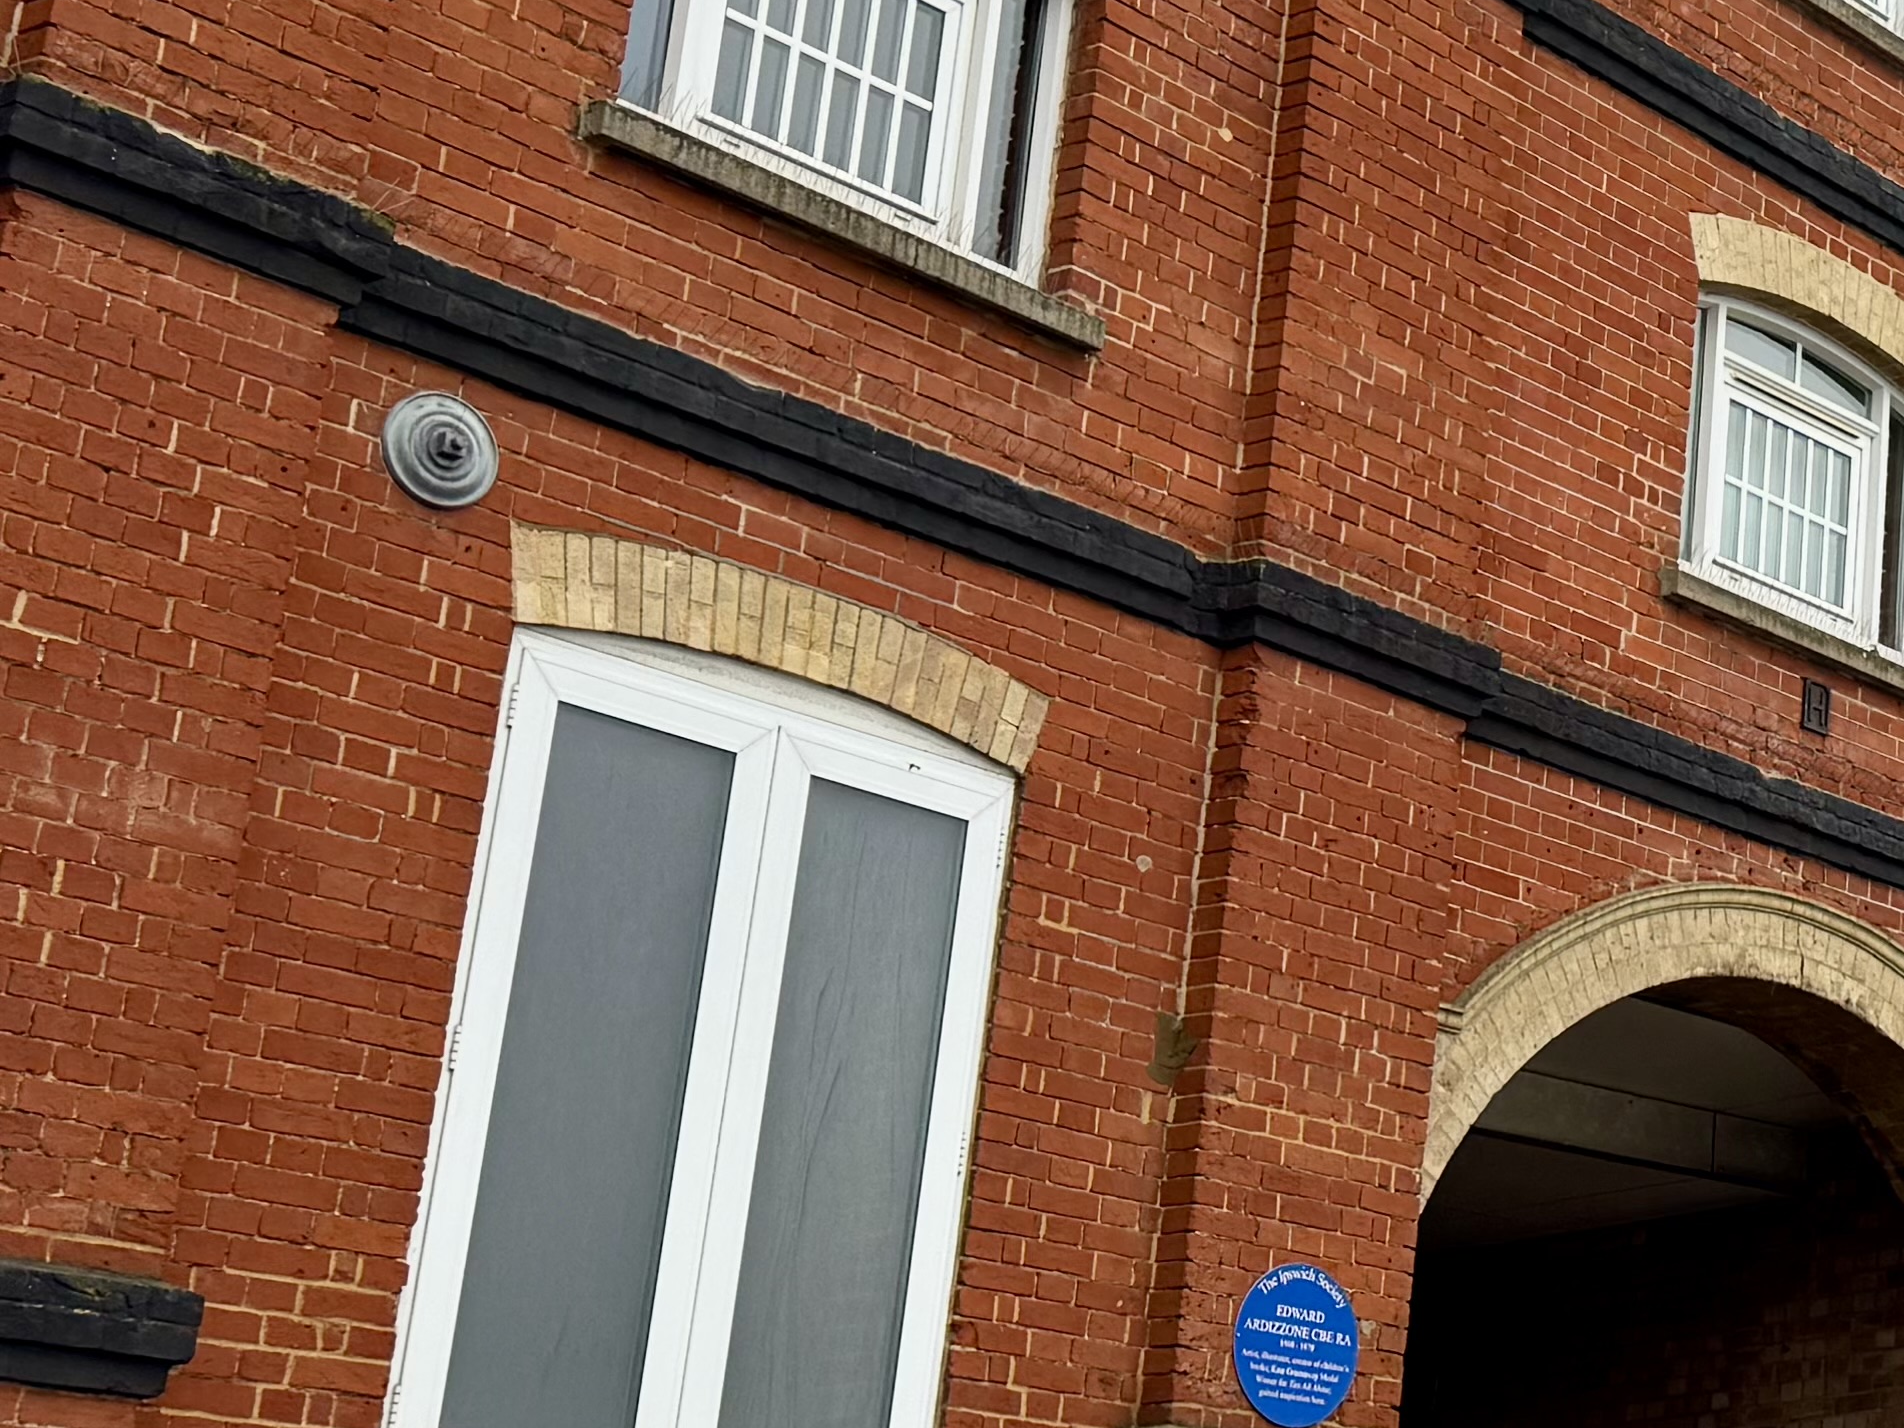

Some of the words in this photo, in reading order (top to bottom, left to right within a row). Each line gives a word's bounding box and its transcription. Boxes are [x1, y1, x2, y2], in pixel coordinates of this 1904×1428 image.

[1257, 1276, 1278, 1294] The
[1279, 1266, 1316, 1285] Ipswich
[1316, 1273, 1347, 1308] Society
[1276, 1304, 1325, 1323] EDWARD
[1244, 1318, 1310, 1339] ARDIZZONE
[1311, 1329, 1334, 1343] CBE
[1336, 1333, 1351, 1346] RA
